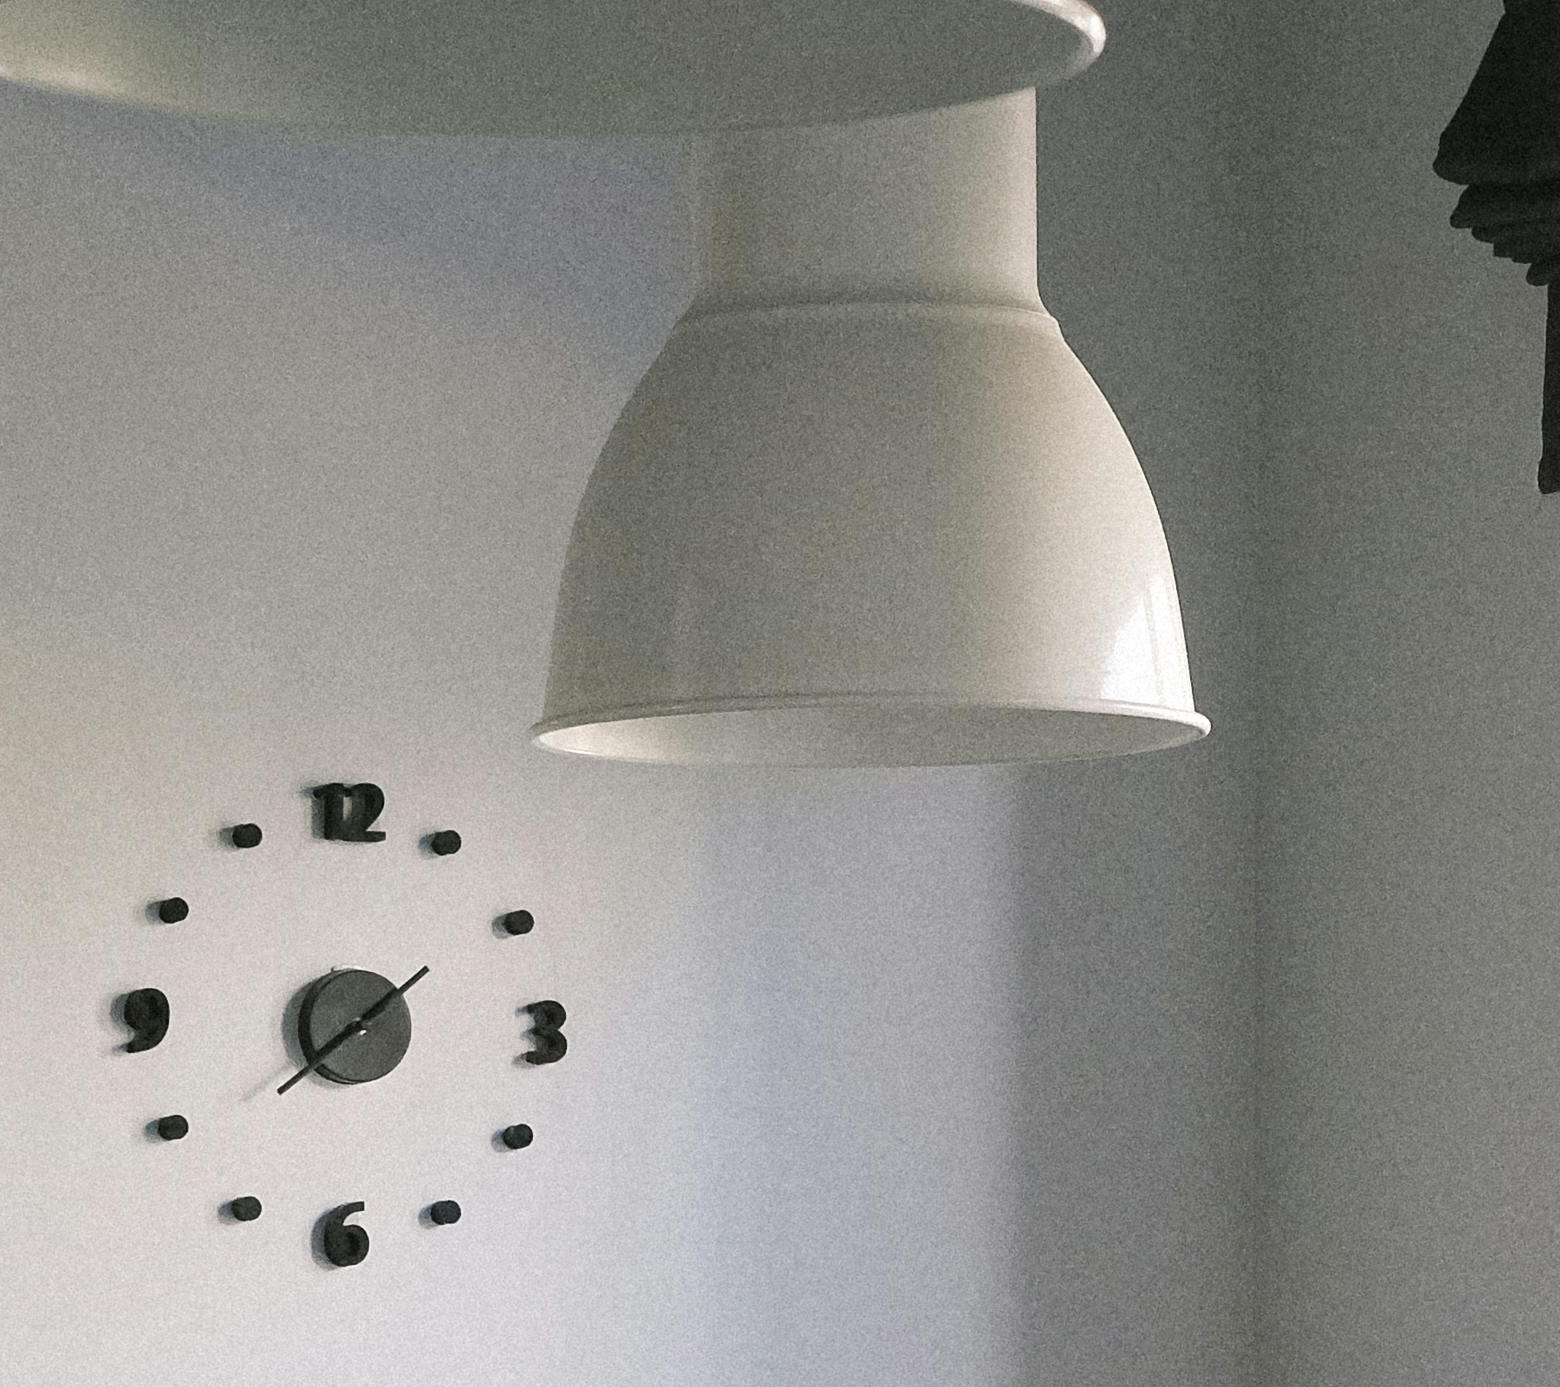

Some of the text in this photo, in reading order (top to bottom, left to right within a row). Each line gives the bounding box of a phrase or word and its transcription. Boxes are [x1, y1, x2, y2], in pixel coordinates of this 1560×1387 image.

[312, 782, 387, 842] 12
[124, 987, 171, 1054] 9
[523, 1000, 568, 1066] 3
[323, 1201, 371, 1267] 6
